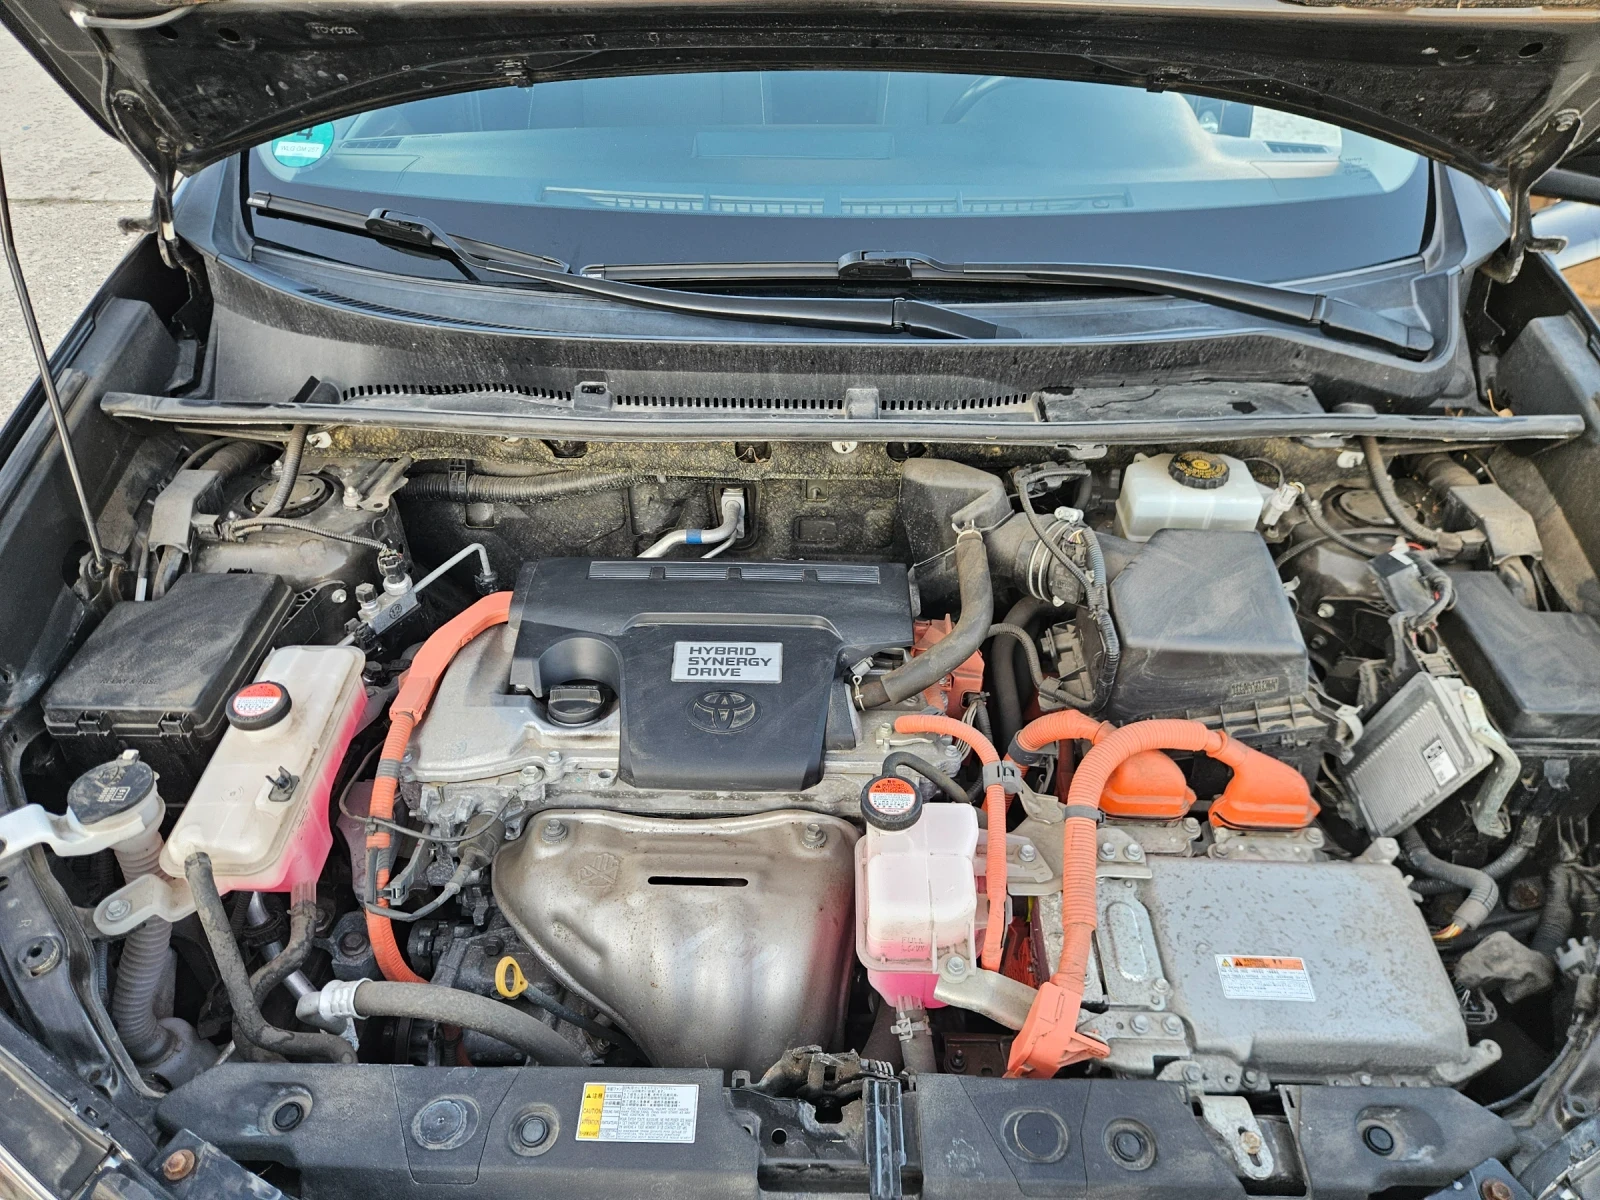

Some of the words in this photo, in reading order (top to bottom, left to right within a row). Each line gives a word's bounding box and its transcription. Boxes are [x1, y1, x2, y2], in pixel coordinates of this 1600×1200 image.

[312, 26, 359, 35] TOYOTA
[689, 646, 756, 656] HYBRID
[687, 656, 772, 667] SYNERGY
[686, 667, 741, 677] DRIVE
[901, 936, 924, 944] FULL
[582, 1107, 602, 1115] CAUTION
